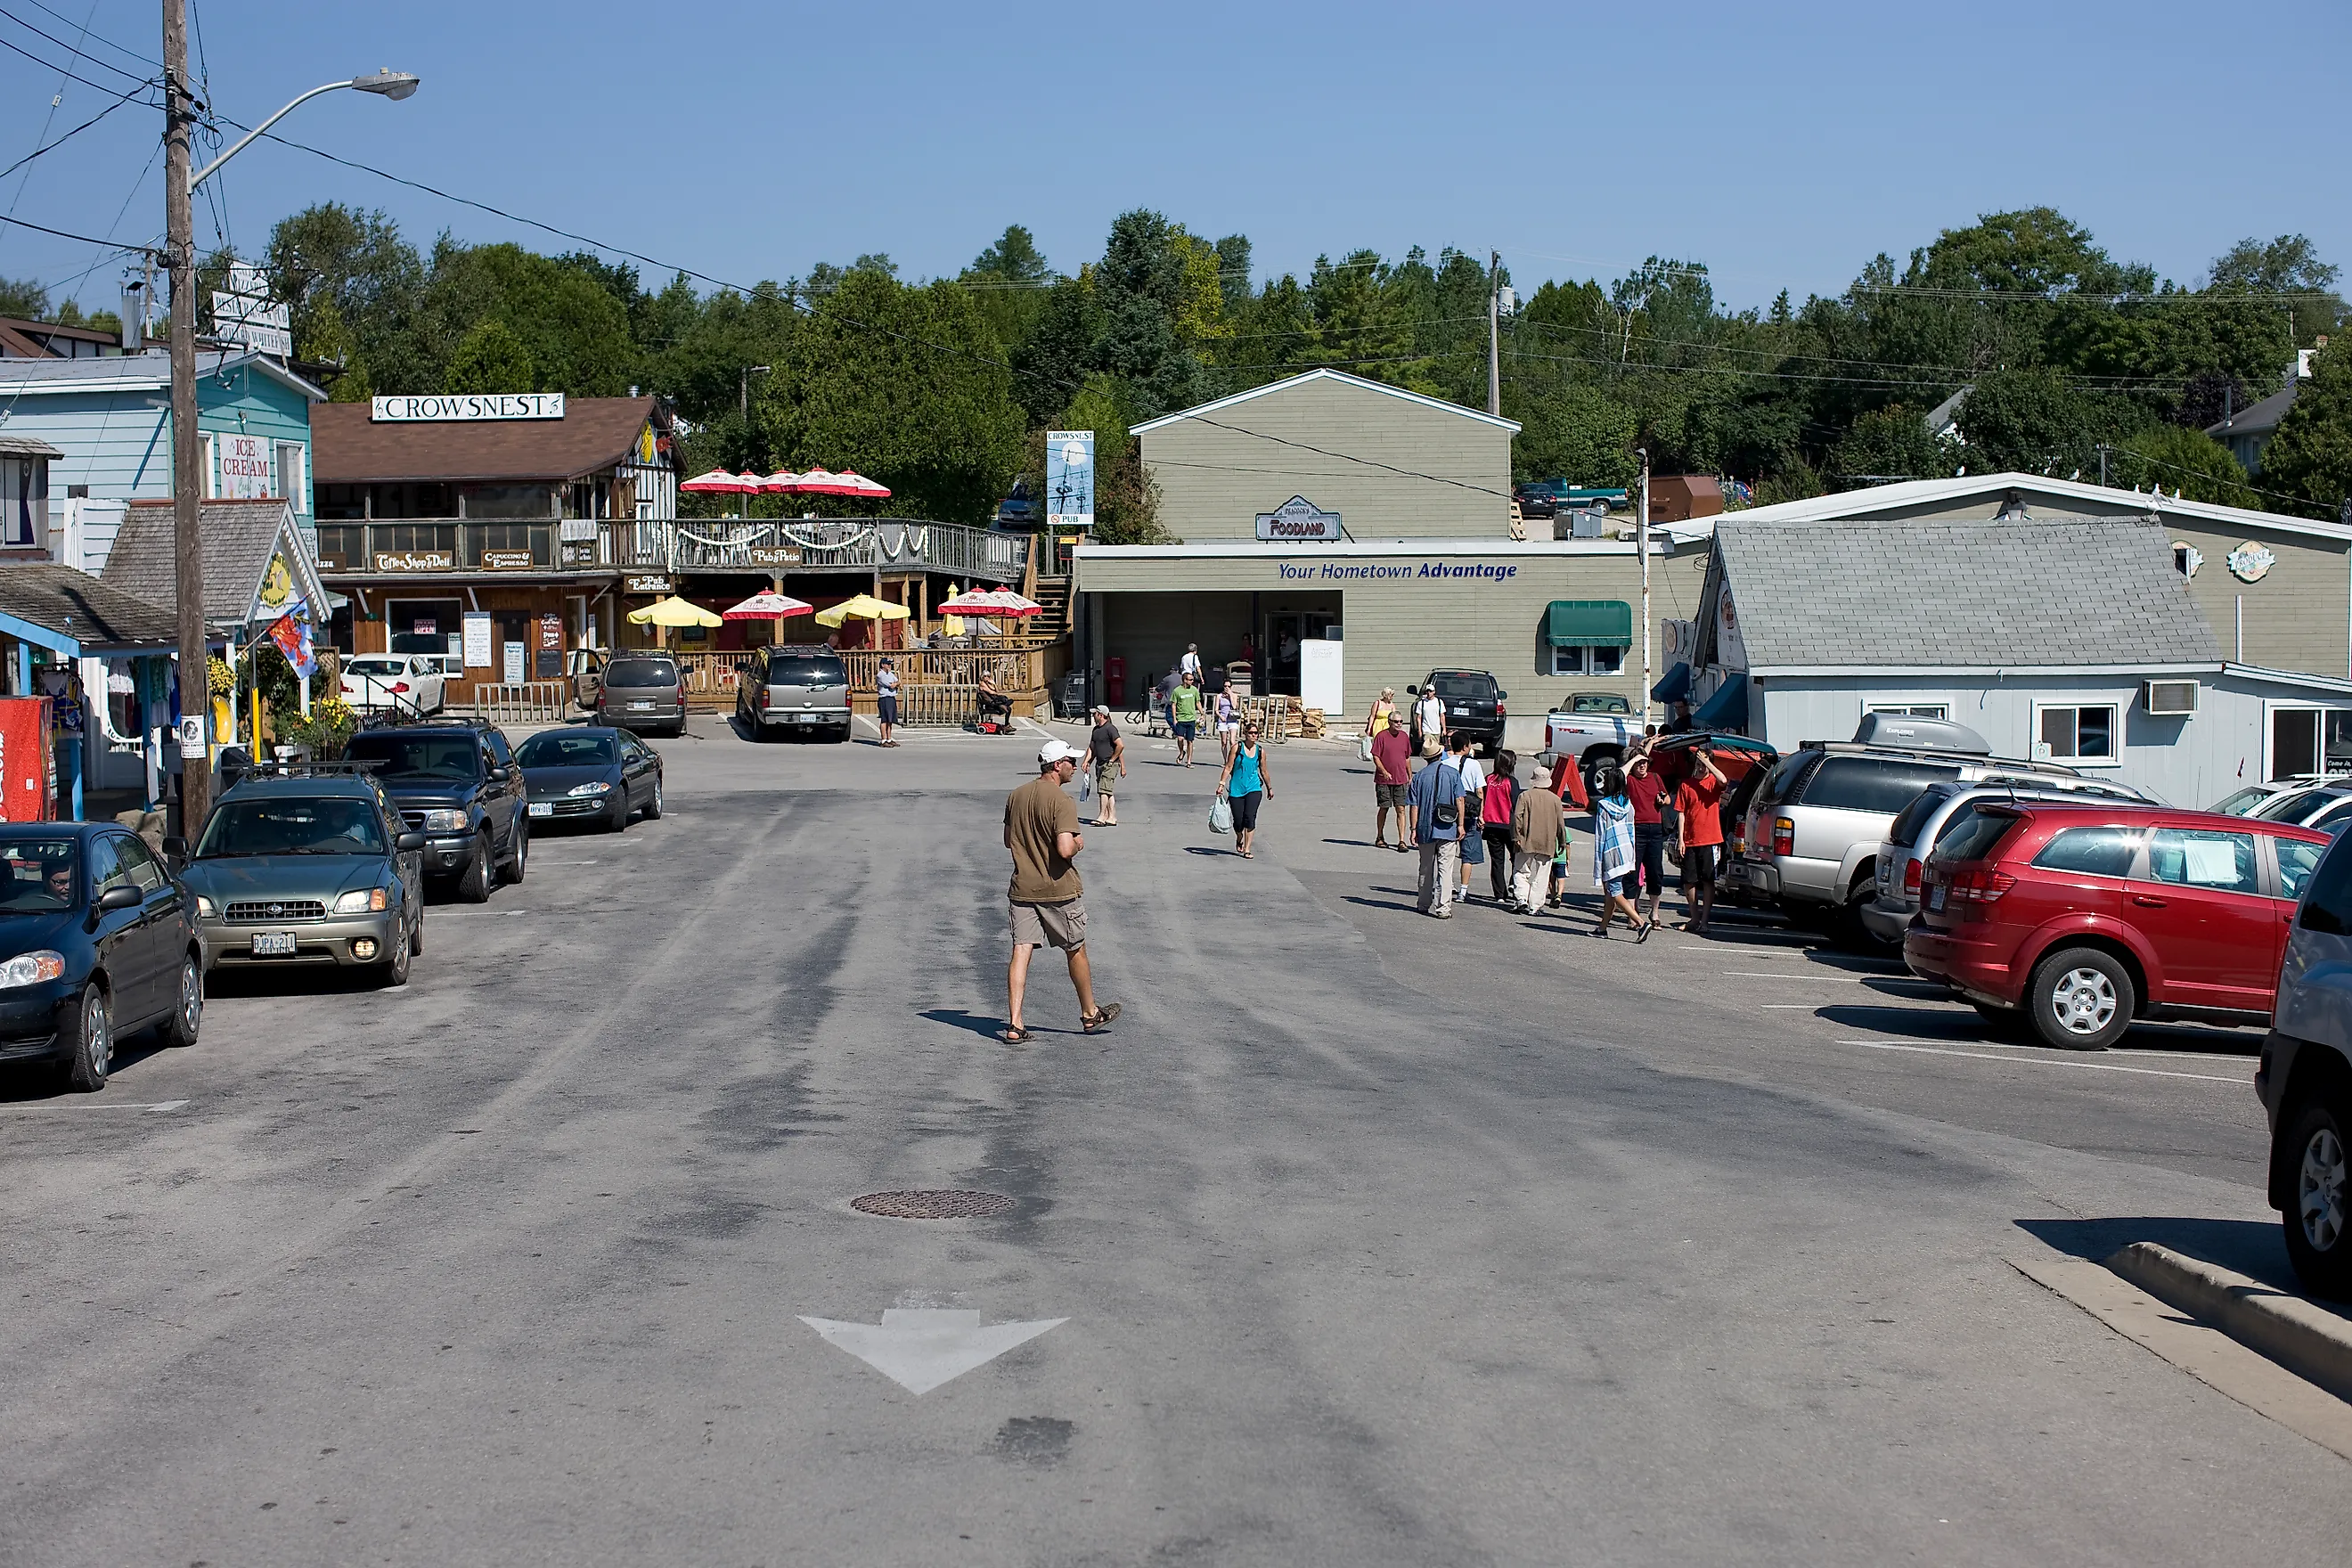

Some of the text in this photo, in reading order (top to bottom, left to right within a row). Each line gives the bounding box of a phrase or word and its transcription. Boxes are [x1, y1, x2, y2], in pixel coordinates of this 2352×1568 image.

[251, 331, 290, 350] WHITEFSH
[385, 396, 548, 418] CROWSNEST
[1048, 432, 1093, 440] CROWSNEST
[235, 439, 256, 457] ICE
[224, 458, 268, 478] CREAM
[1062, 515, 1079, 523] PUB
[1270, 519, 1326, 536] FOODLAND
[376, 553, 405, 570] Coffee
[404, 553, 426, 569] Shop
[753, 549, 773, 562] Pub
[775, 549, 800, 561] Patio
[2234, 551, 2266, 570] PRODUCE
[316, 559, 334, 568] izza
[1279, 562, 1517, 582] Your Hometown Advantage
[627, 577, 671, 591] Entrance
[642, 576, 665, 584] Pub
[416, 625, 436, 633] OPEN
[34, 653, 40, 664] 8
[1886, 727, 1915, 735] EXPLORER
